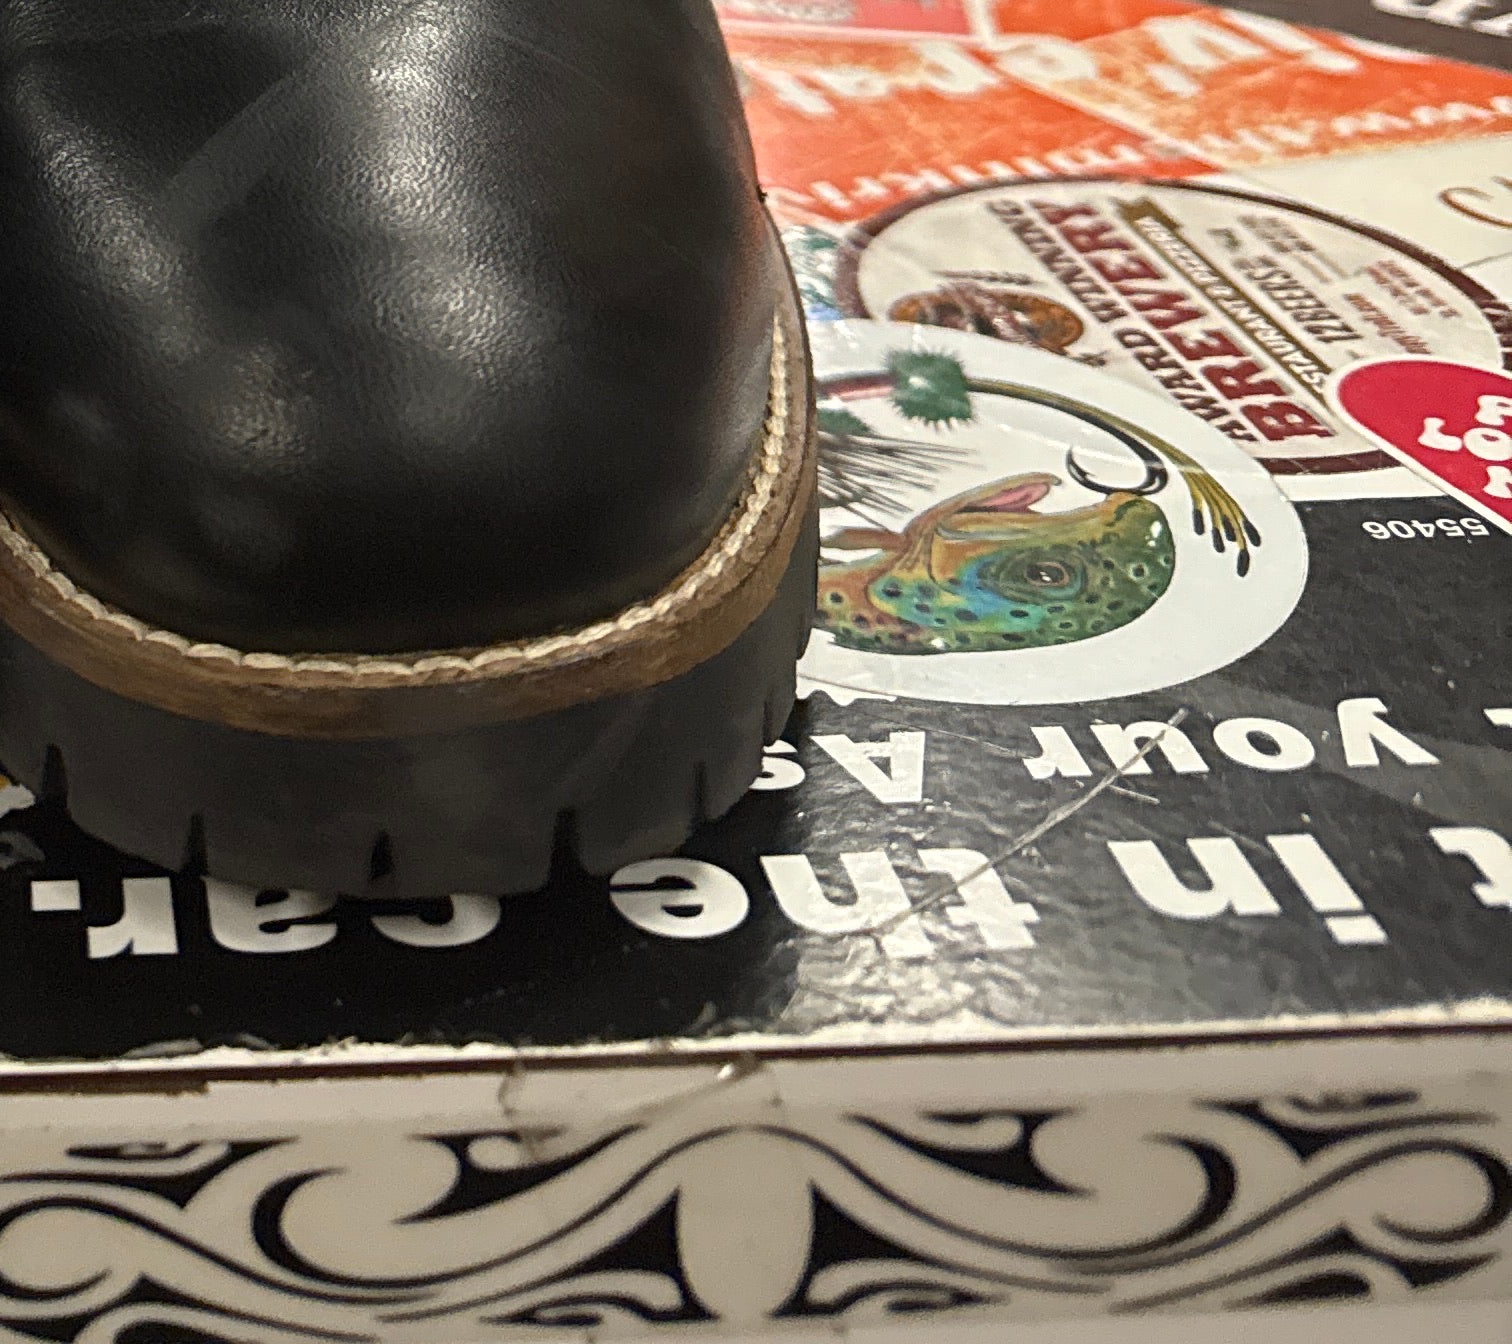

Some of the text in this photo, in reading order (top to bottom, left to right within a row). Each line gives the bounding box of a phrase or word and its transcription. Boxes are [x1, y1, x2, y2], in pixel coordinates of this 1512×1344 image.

[988, 201, 1126, 323] WINNING
[1029, 201, 1334, 441] BREWERY
[1114, 328, 1259, 442] AWARD
[1361, 518, 1490, 540] 55406
[1024, 698, 1438, 780] your
[31, 874, 501, 958] car.
[609, 858, 1040, 959] the
[1108, 834, 1389, 945] in
